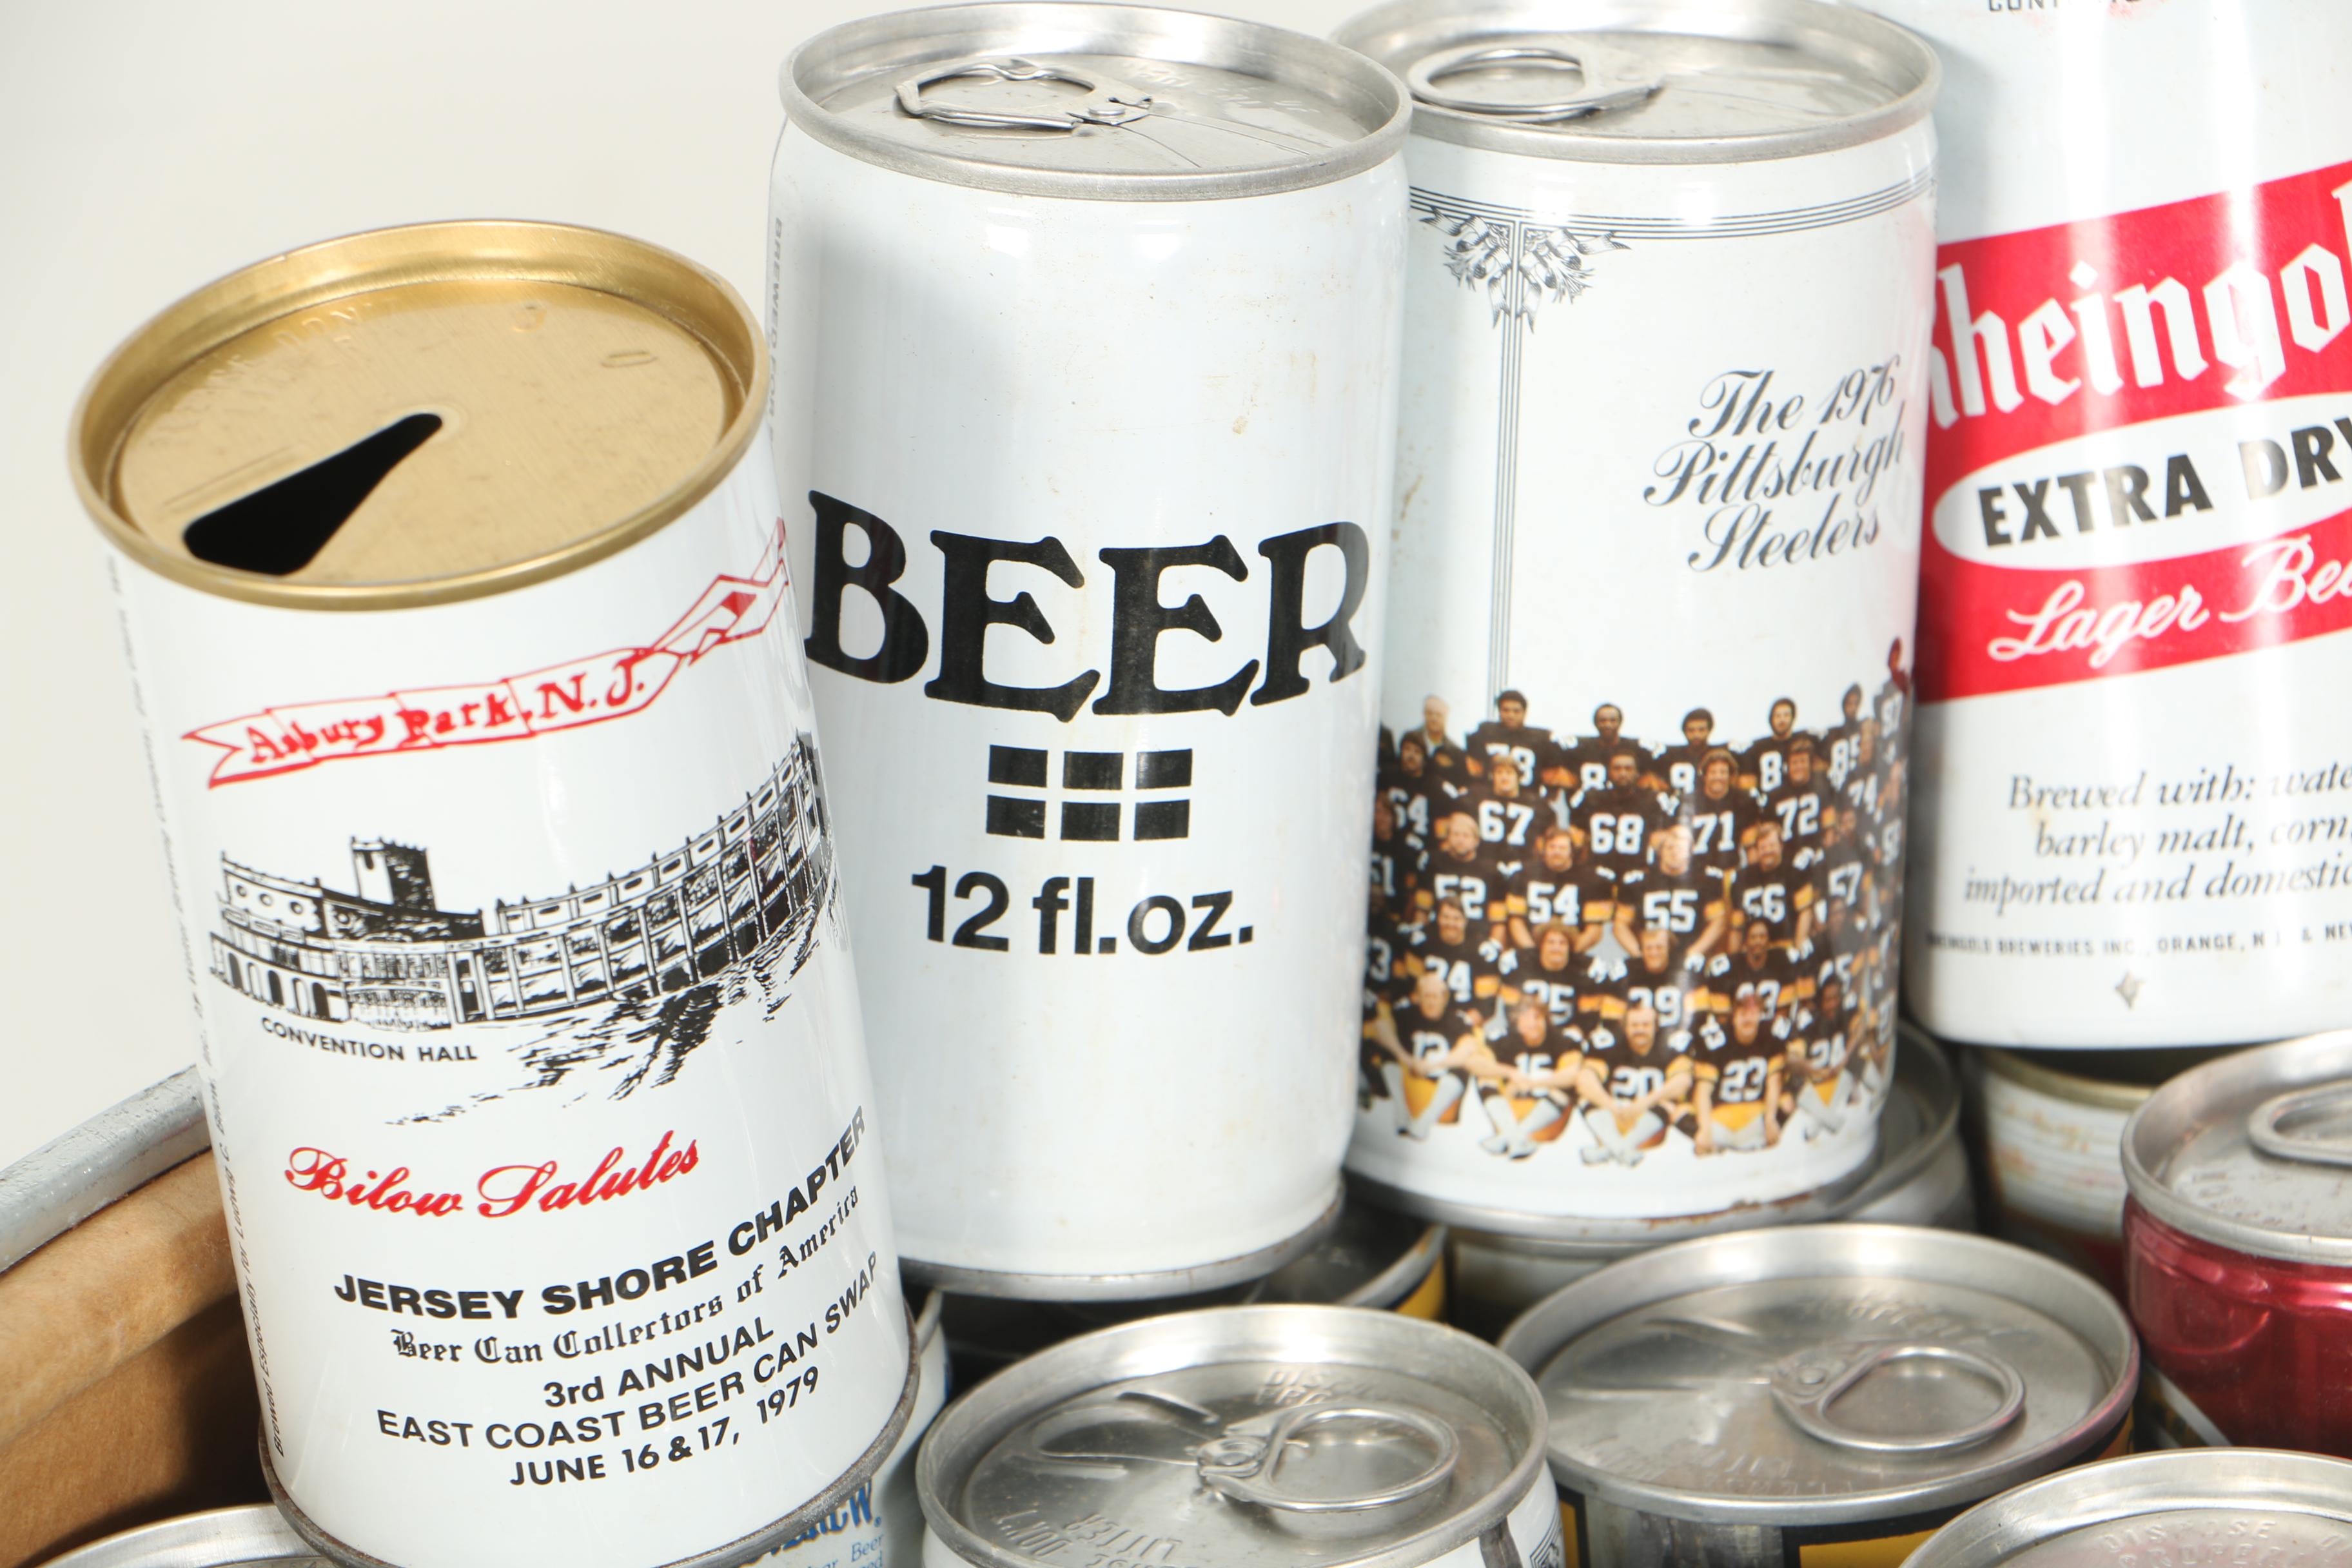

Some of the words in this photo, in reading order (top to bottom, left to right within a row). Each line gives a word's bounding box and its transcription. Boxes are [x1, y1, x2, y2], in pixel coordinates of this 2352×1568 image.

[1688, 369, 1805, 438] The
[1817, 354, 1900, 426] 1976
[1643, 400, 1906, 507] Pittsburgh
[1977, 453, 2215, 547] EXTRA
[1687, 493, 1880, 573] Steelers
[802, 489, 1370, 724] BEER
[1988, 580, 2211, 668] Lager
[247, 716, 384, 763] Asbury
[1388, 787, 1428, 836] 64
[2008, 771, 2146, 810] Brewed
[2158, 765, 2255, 806] with:
[1478, 800, 1534, 846] 67
[1589, 813, 1644, 854] 68
[1692, 810, 1735, 854] 71
[1776, 792, 1820, 842] 72
[2035, 821, 2145, 869] barley
[2158, 814, 2255, 855] malt,
[910, 864, 1010, 952] 12
[1434, 874, 1487, 919] 52
[1527, 881, 1580, 925] 54
[1643, 889, 1699, 933] 55
[1743, 884, 1786, 923] 56
[1965, 867, 2106, 917] imported
[2114, 863, 2195, 902] and
[2157, 932, 2246, 953] ORANGE,
[261, 1017, 404, 1061] CONVENTION
[418, 1044, 478, 1061] HALL
[1613, 1067, 1665, 1106] 20
[1720, 1057, 1767, 1101] 23
[285, 1147, 464, 1217] Bilow
[478, 1130, 698, 1218] Salutes
[221, 1166, 242, 1240] Ludwig
[334, 1274, 525, 1319] JERSEY
[541, 1240, 718, 1315] SHORE
[729, 1105, 865, 1256] CHAPTER
[235, 1240, 251, 1275] for
[390, 1329, 463, 1362] Beer
[474, 1336, 544, 1364] Can
[553, 1295, 723, 1360] Collectors
[737, 1264, 763, 1303] of
[778, 1186, 858, 1279] America
[242, 1275, 270, 1377] Especially
[377, 1409, 473, 1447] EAST
[485, 1410, 625, 1449] COAST
[638, 1371, 745, 1431] BEER
[754, 1323, 818, 1384] CAN
[825, 1251, 876, 1334] SWAP
[544, 1375, 605, 1408] 3rd
[618, 1317, 774, 1396] ANNUAL
[261, 1378, 284, 1458] Brewed
[511, 1455, 606, 1486] JUNE
[622, 1444, 659, 1473] 16
[668, 1435, 692, 1462] &
[698, 1416, 740, 1450] 17,
[756, 1366, 818, 1424] 1979
[851, 1533, 884, 1562] Beer
